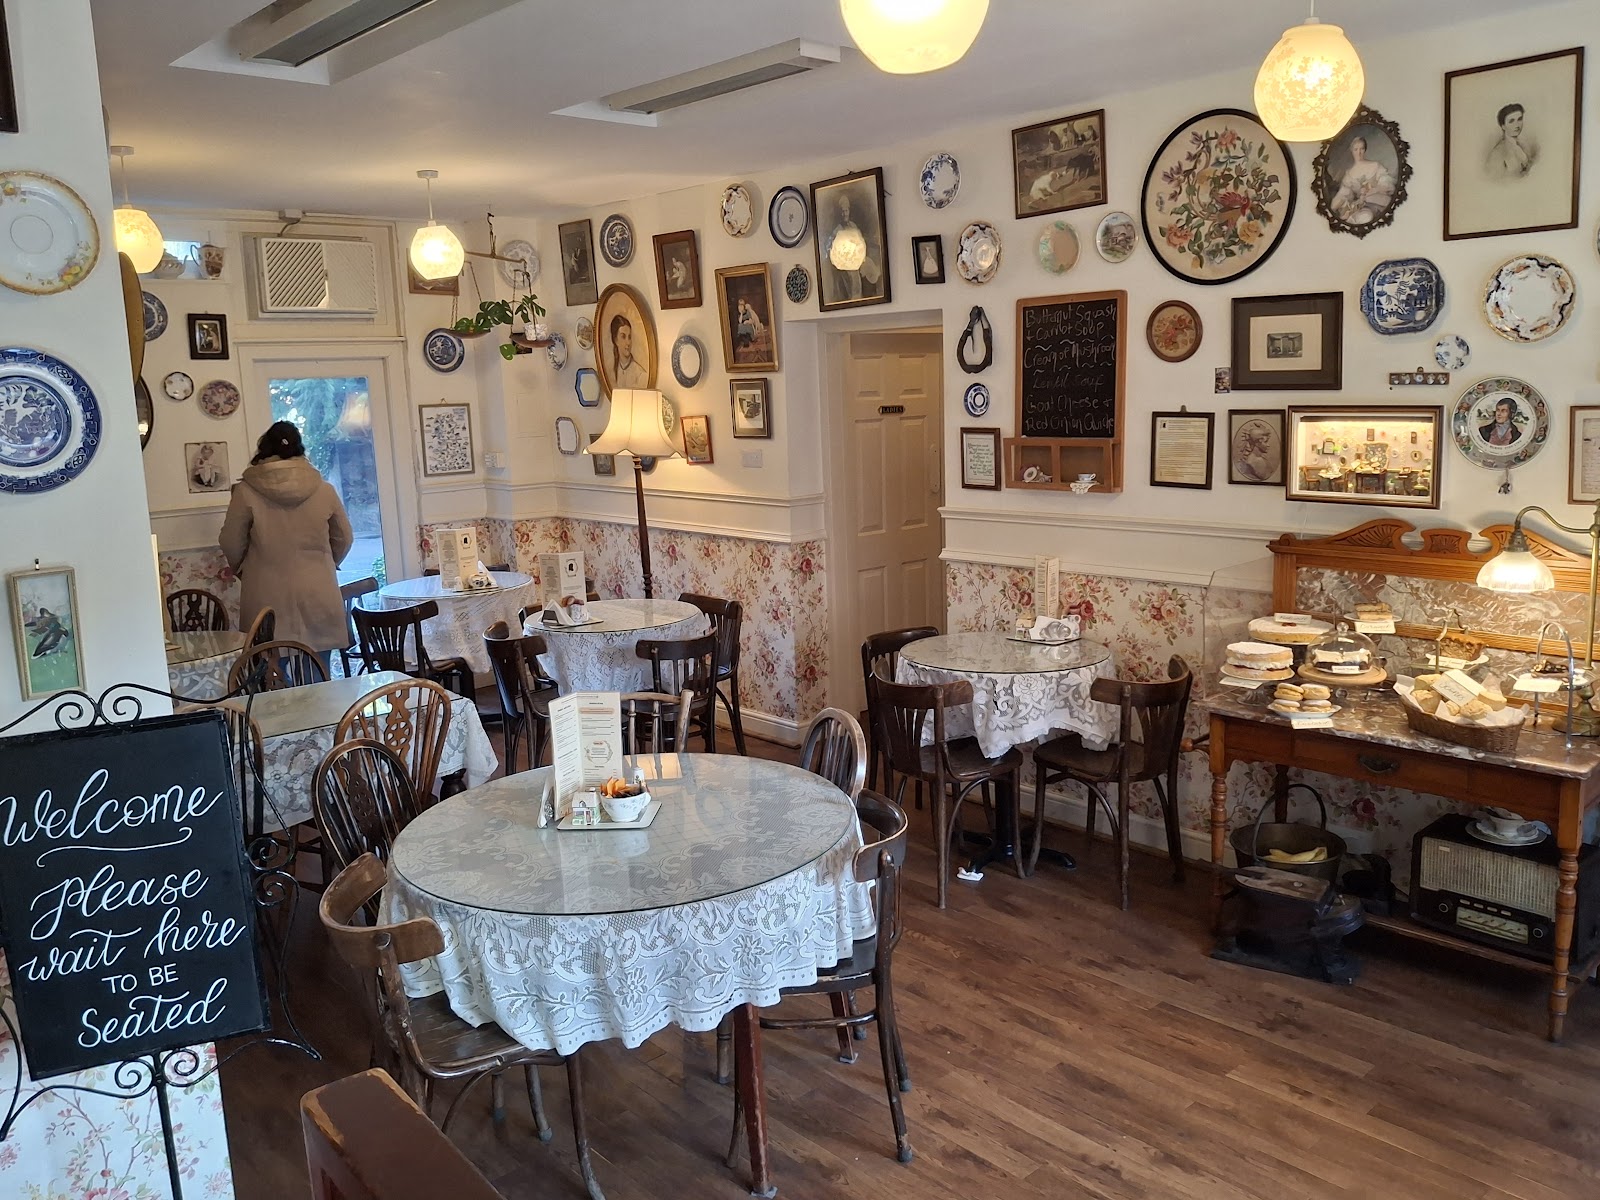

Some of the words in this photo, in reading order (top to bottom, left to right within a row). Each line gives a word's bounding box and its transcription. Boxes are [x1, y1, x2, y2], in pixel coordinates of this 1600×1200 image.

[1076, 303, 1116, 327] Squash
[1036, 322, 1073, 340] Carrot
[1075, 321, 1104, 338] Soup
[1024, 347, 1057, 372] Cream
[1060, 346, 1069, 359] of
[1025, 416, 1048, 431] Red
[0, 768, 223, 846] Welcome
[18, 927, 142, 981] wait
[144, 907, 246, 958] here
[102, 974, 137, 993] TO
[149, 963, 179, 986] BE
[78, 978, 227, 1047] Seated
